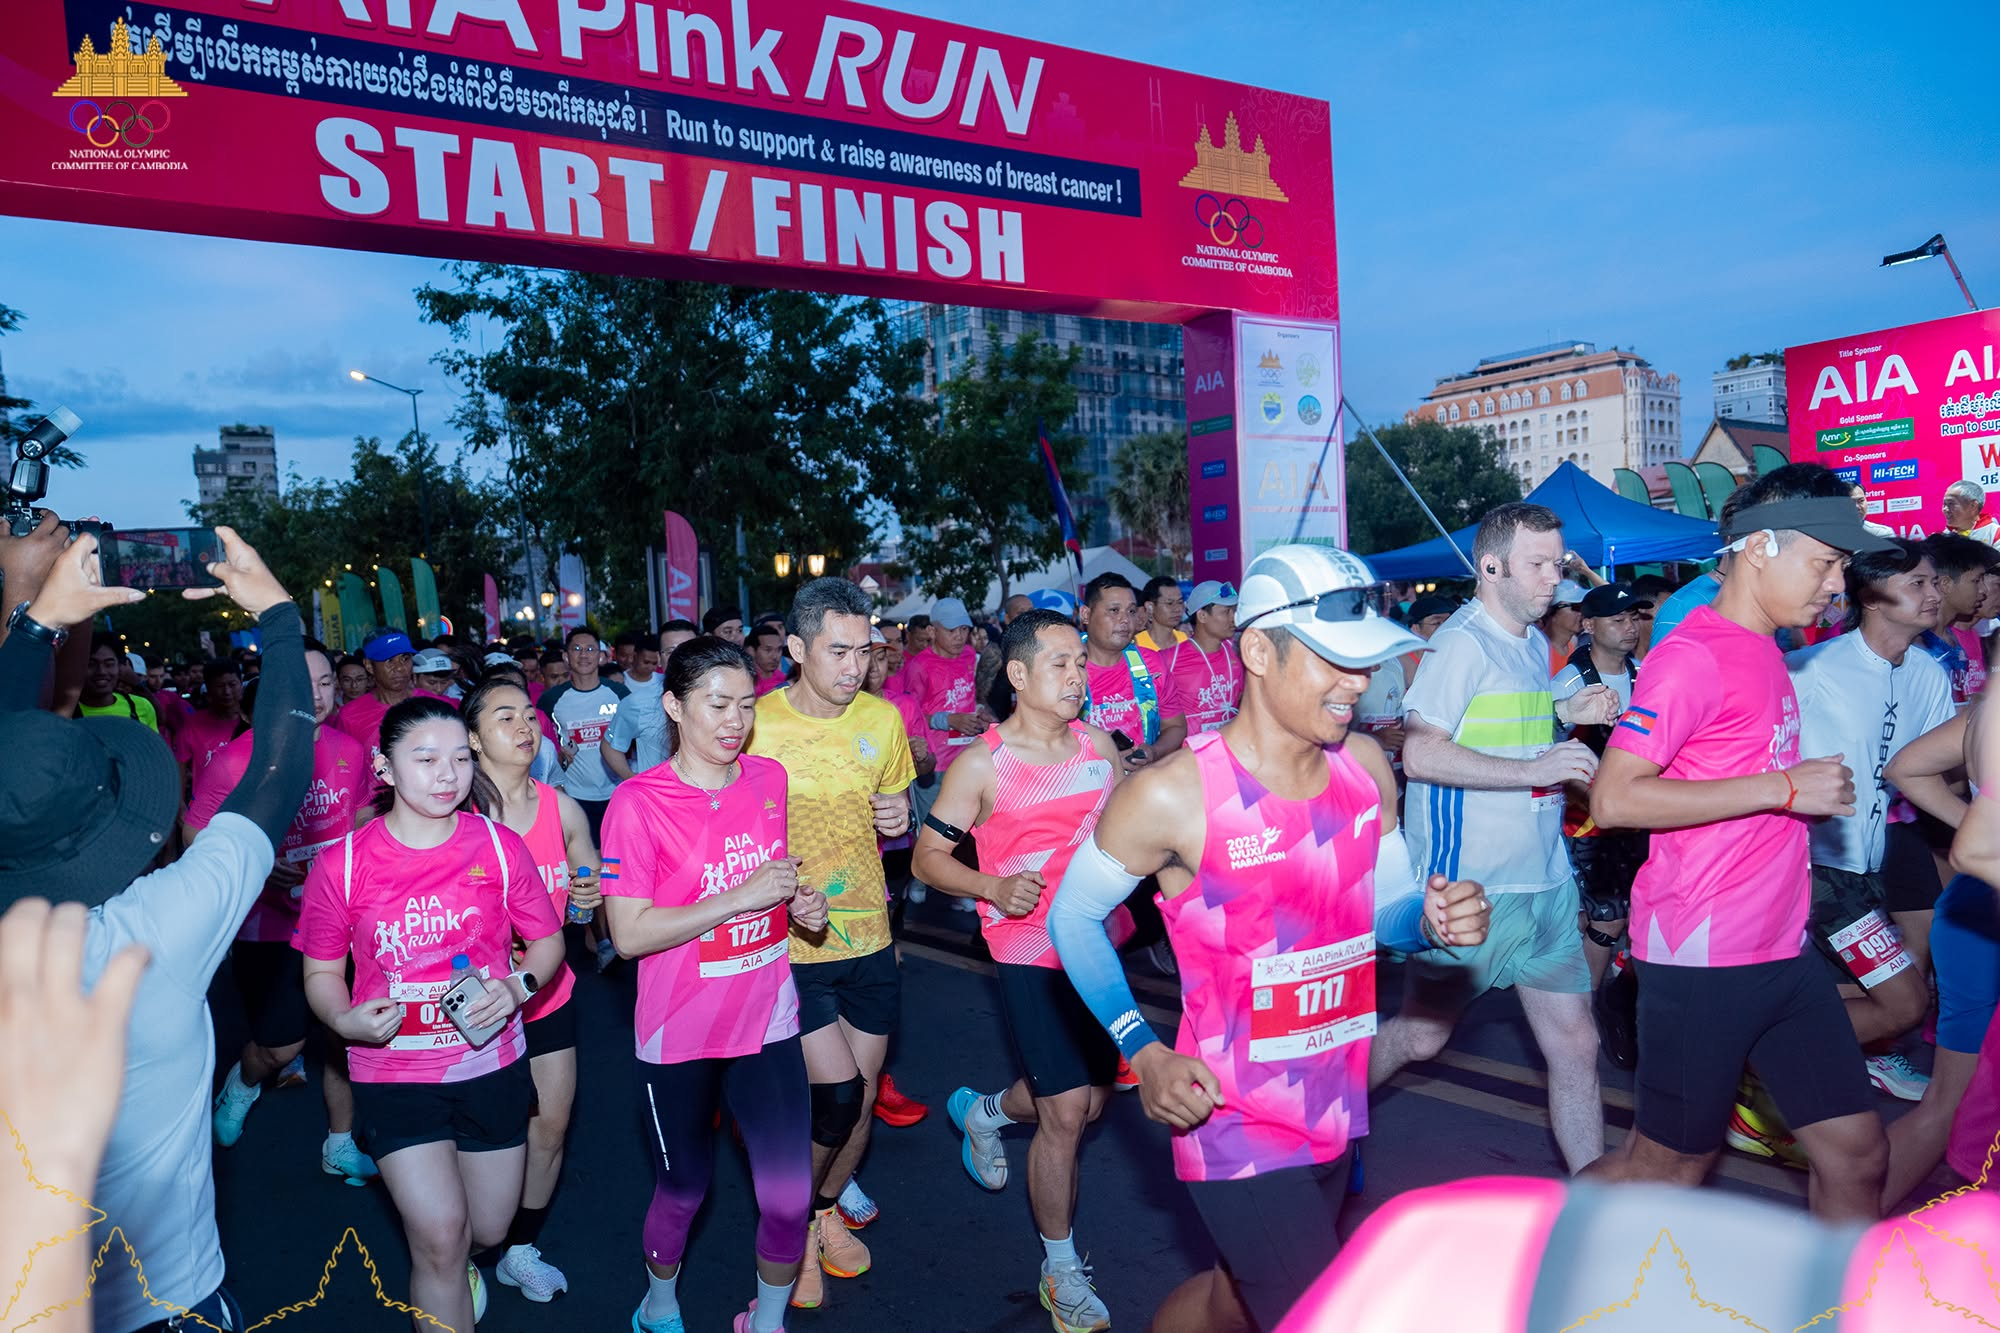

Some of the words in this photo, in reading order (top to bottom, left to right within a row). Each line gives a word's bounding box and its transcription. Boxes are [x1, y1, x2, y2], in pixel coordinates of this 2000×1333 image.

[804, 14, 1045, 136] RUN
[665, 108, 709, 144] Run
[713, 118, 734, 147] to
[738, 126, 816, 160] support
[820, 138, 836, 163] &
[839, 139, 886, 170] raise
[889, 150, 984, 185] awareness
[985, 160, 1003, 187] of
[1005, 161, 1058, 195] breast
[314, 116, 666, 246] START
[688, 170, 729, 252] /
[751, 176, 1026, 284] FINISH
[1196, 244, 1241, 259] NATIONAL
[1241, 249, 1279, 263] OLYMPIC
[1181, 255, 1235, 271] COMMITTEE
[1235, 261, 1247, 273] OF
[1247, 263, 1294, 278] CAMBODIA
[1839, 350, 1854, 358] Title
[1854, 345, 1882, 356] Sponsor
[1944, 344, 2000, 388] AI
[1193, 370, 1226, 395] AIA
[1808, 354, 1920, 411] AIA
[1839, 415, 1855, 425] Gold
[1855, 412, 1884, 422] Sponsor
[1941, 423, 1964, 437] Run
[1966, 422, 1979, 432] to
[1843, 451, 1887, 462] Co-Sponsors
[1873, 464, 1916, 479] HI-TECH
[1210, 673, 1227, 684] AIA
[598, 703, 618, 716] AX
[1105, 713, 1124, 725] RUN
[579, 727, 602, 740] 1225
[308, 779, 328, 791] IA
[303, 788, 341, 808] Pink
[305, 805, 329, 817] RUN
[724, 832, 755, 853] AIA
[1226, 834, 1260, 851] 2025
[724, 844, 772, 875] Pink
[1228, 845, 1264, 861] WUXI
[1230, 850, 1287, 871] MARATHON
[404, 895, 443, 912] AIA
[404, 908, 462, 935] Pink
[408, 932, 445, 948] RUN
[727, 915, 772, 948] 1722
[740, 954, 764, 970] AIA
[1889, 955, 1908, 972] AIA
[1293, 973, 1346, 1018] 1717
[432, 1033, 460, 1045] AIA
[1304, 1029, 1335, 1051] AIA
